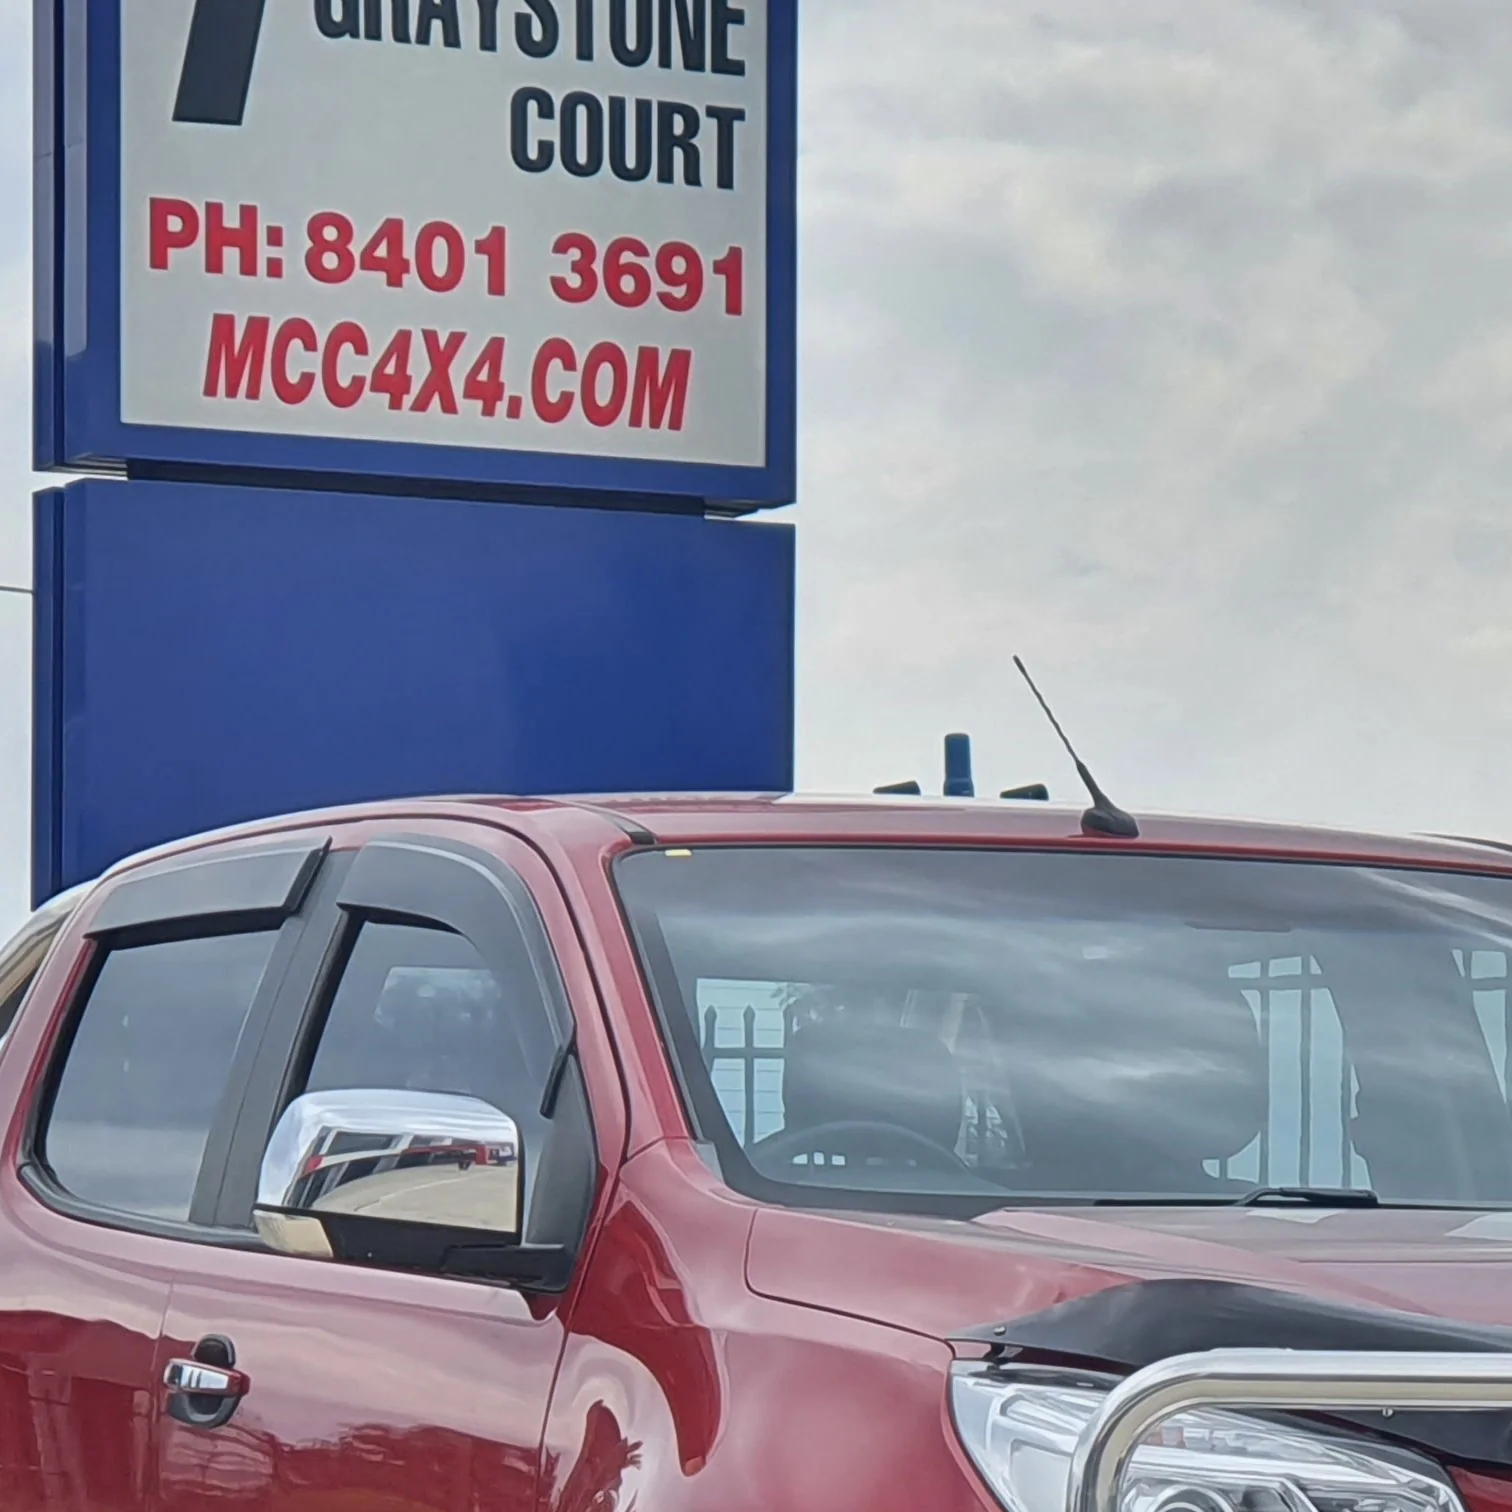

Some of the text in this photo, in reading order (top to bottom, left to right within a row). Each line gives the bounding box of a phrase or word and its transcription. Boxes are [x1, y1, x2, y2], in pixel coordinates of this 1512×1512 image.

[510, 86, 746, 191] COURT
[149, 197, 744, 316] PH: 8401 3691
[203, 313, 692, 432] MCC4X4.COM
